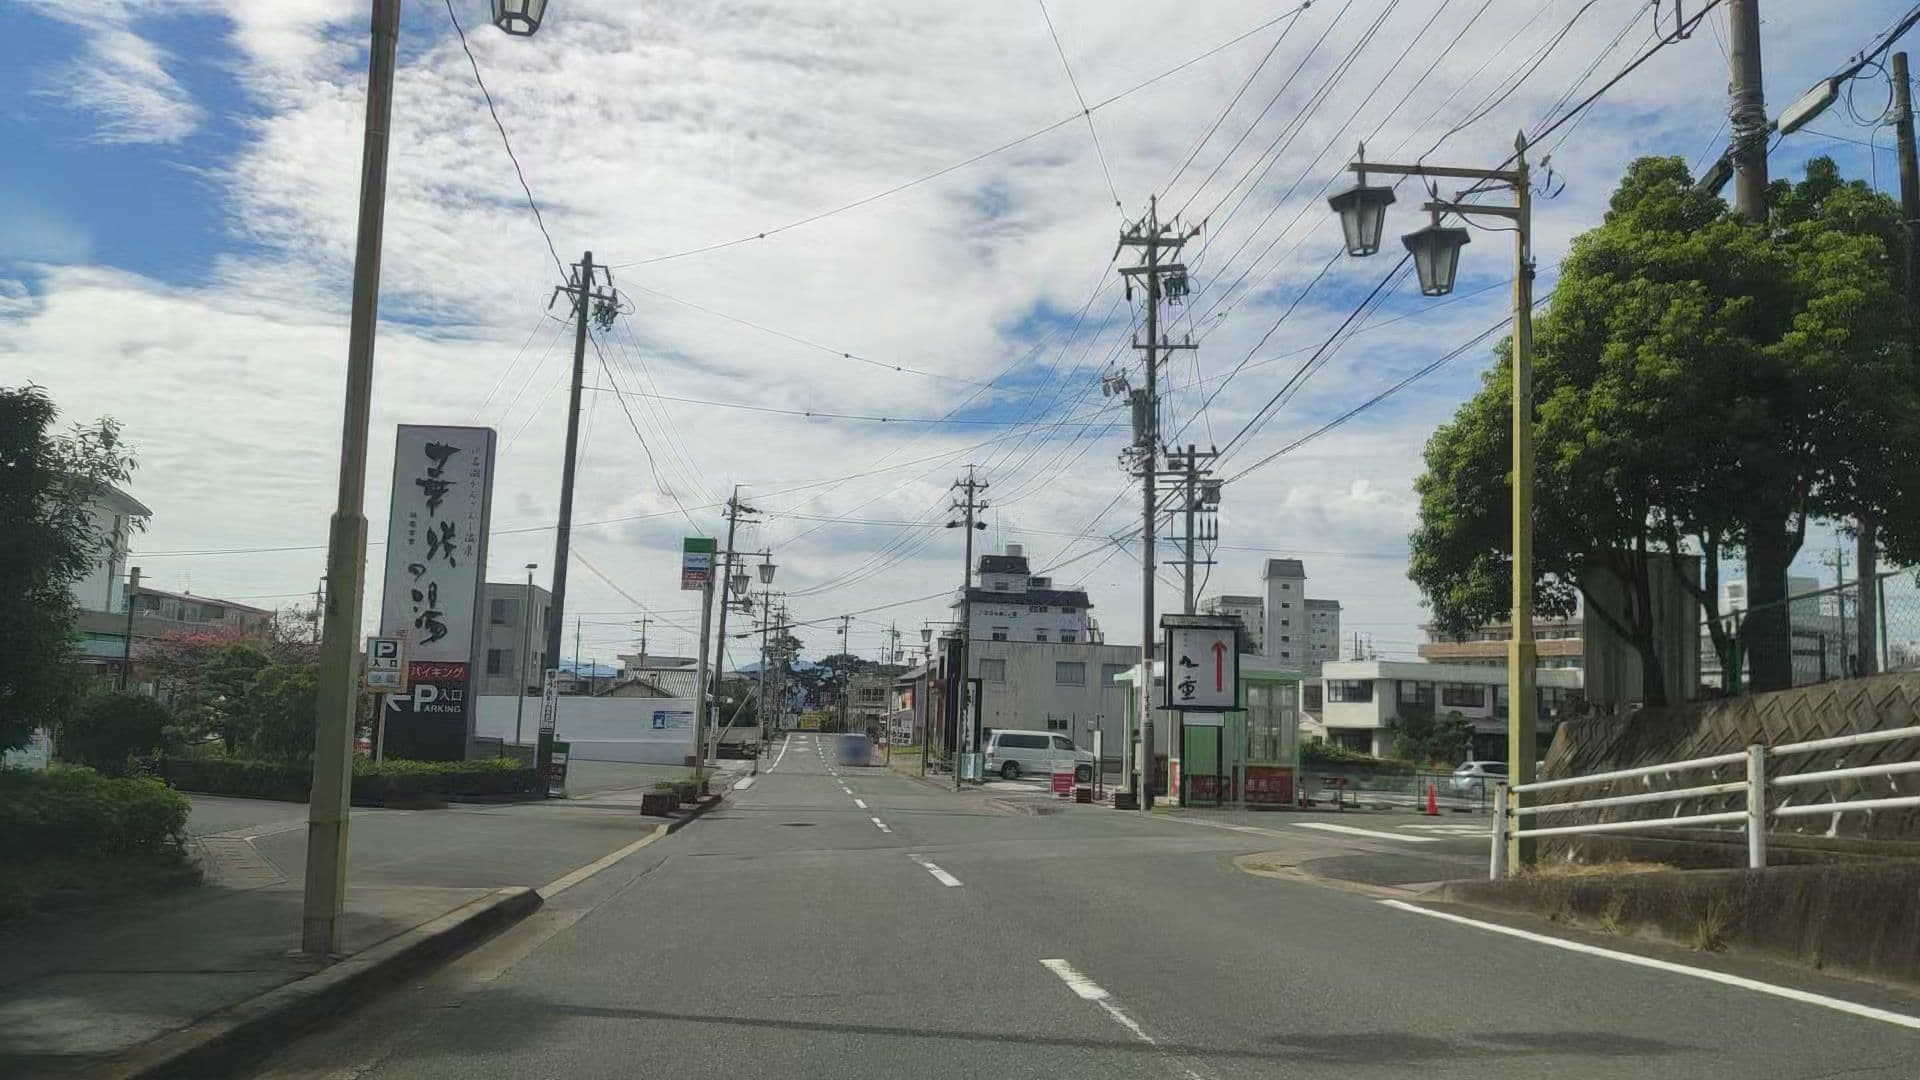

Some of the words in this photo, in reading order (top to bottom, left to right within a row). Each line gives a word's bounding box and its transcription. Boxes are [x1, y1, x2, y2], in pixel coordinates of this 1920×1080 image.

[372, 659, 398, 668] 入口
[410, 665, 464, 679] バイキング
[439, 689, 463, 702] 入口
